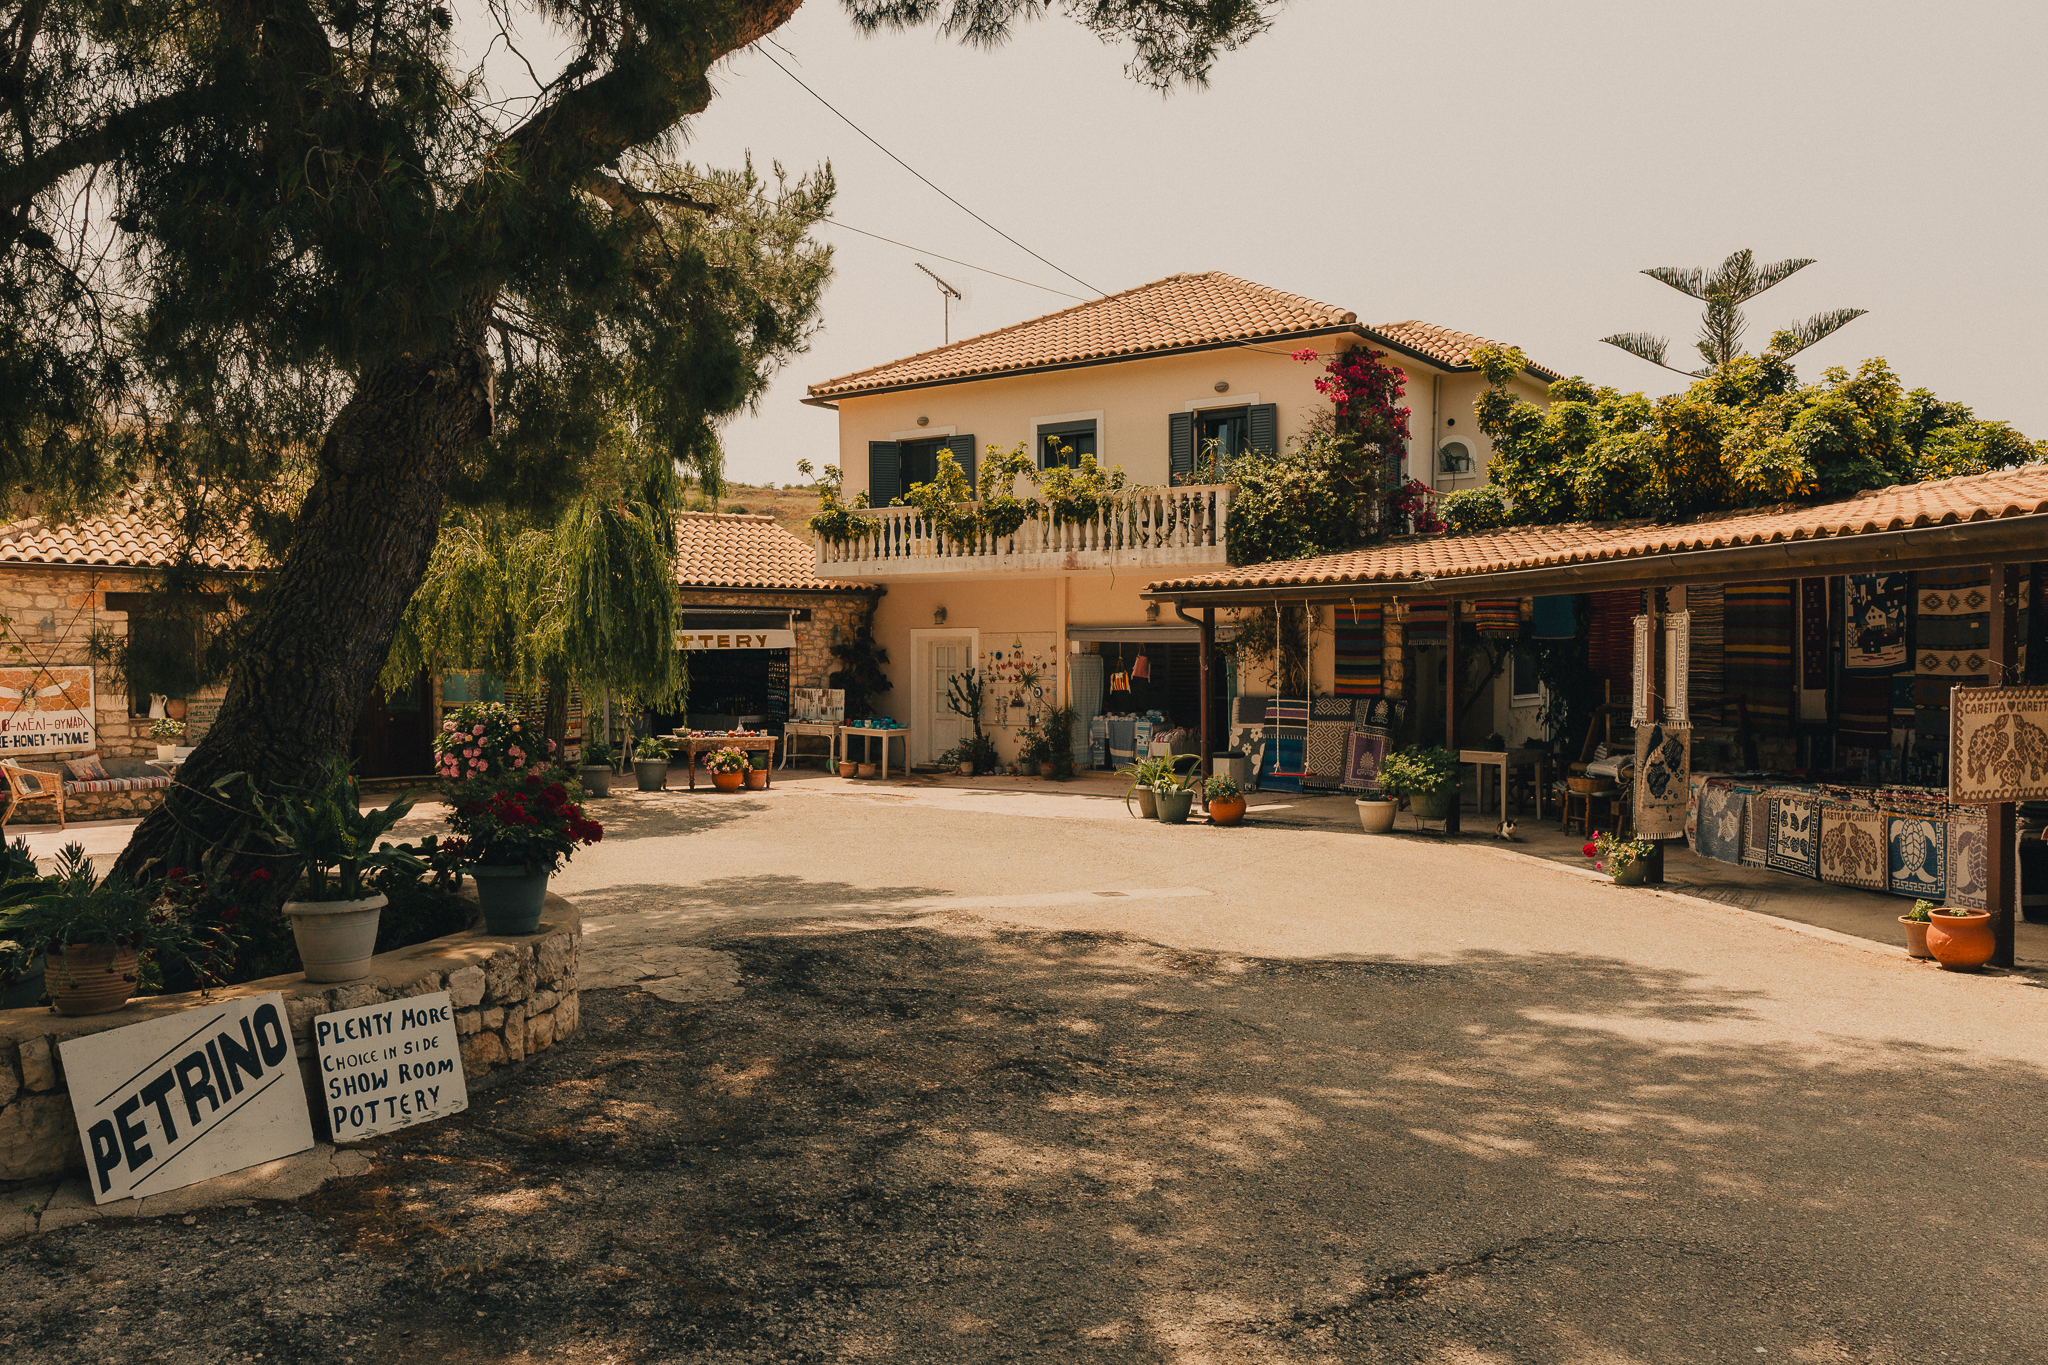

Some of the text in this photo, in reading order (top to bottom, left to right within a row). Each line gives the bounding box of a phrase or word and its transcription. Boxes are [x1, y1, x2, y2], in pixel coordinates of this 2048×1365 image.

[1964, 702, 2006, 715] CARETTA
[1851, 812, 1879, 823] CARETTA
[316, 1005, 450, 1047] PLENTY MORE
[323, 1050, 379, 1073] CHOICE
[329, 1058, 454, 1100] SHOW ROOM
[86, 1003, 288, 1196] PETRINO
[333, 1085, 440, 1134] POTTERY
